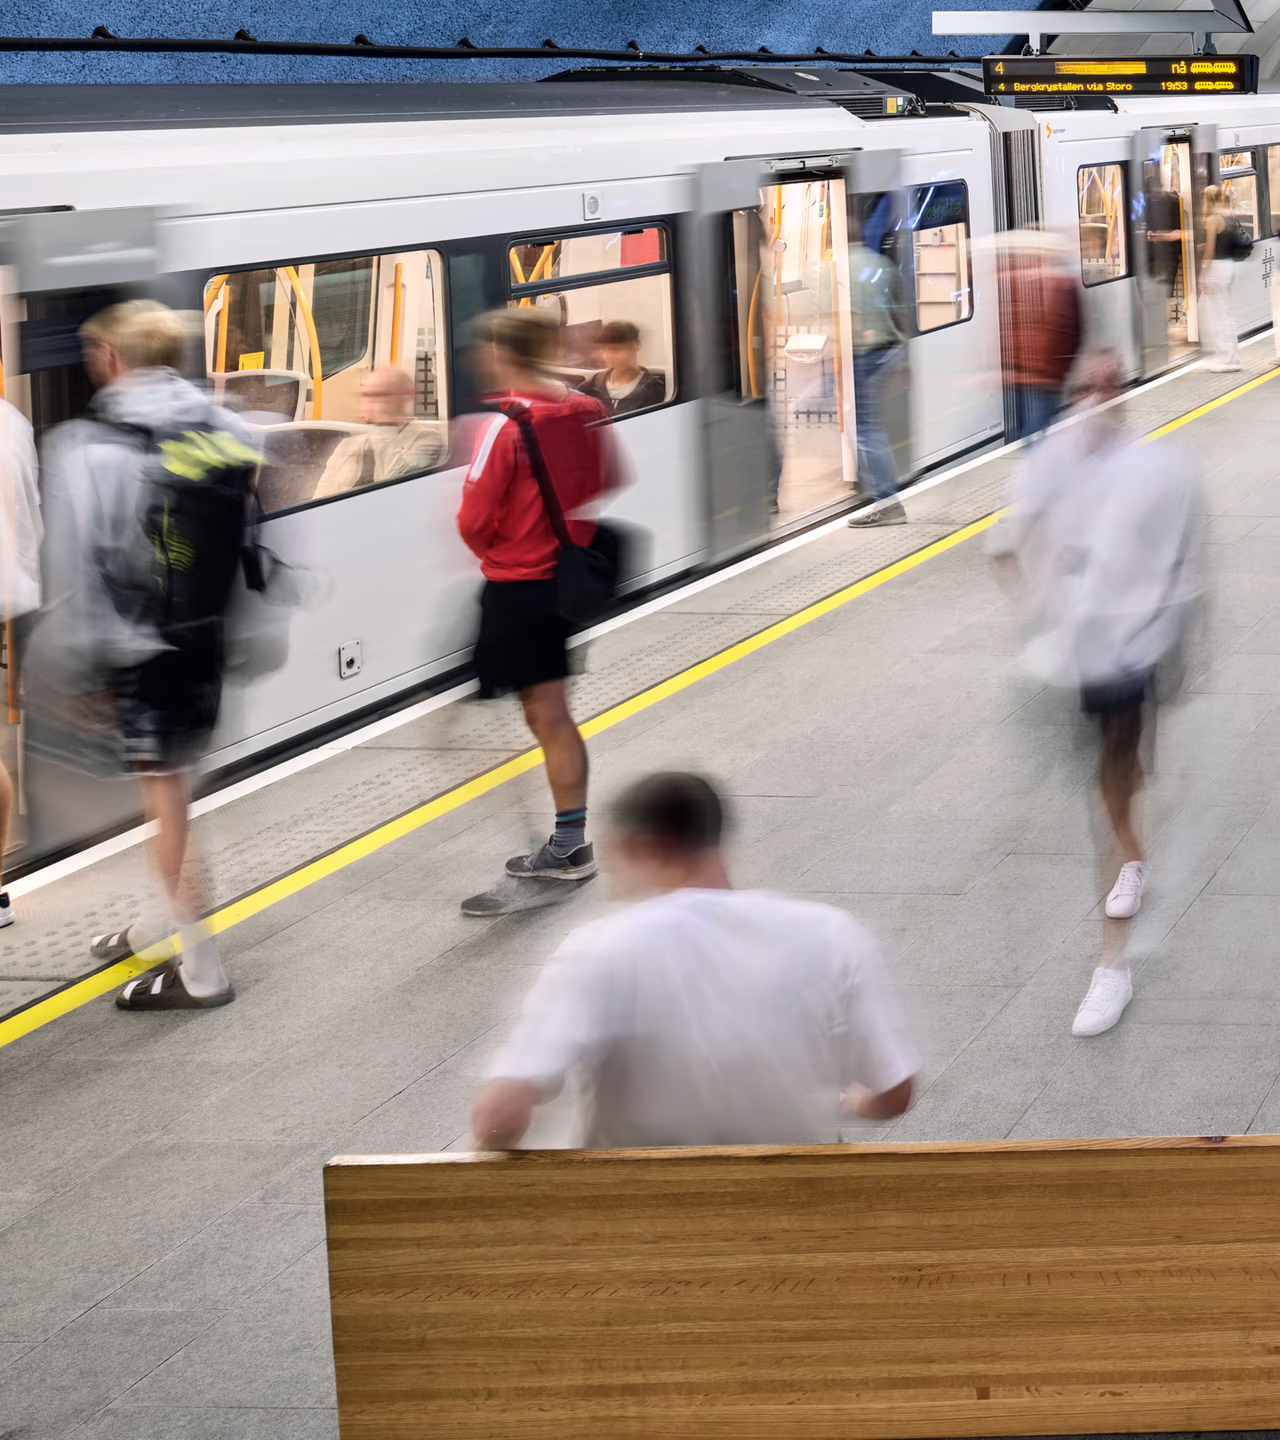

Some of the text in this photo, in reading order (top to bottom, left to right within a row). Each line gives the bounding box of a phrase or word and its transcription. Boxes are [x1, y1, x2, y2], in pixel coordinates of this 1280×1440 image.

[994, 60, 1187, 75] 4 nå
[998, 81, 1188, 92] 4 Bergkrystallen via Storo 19:53
